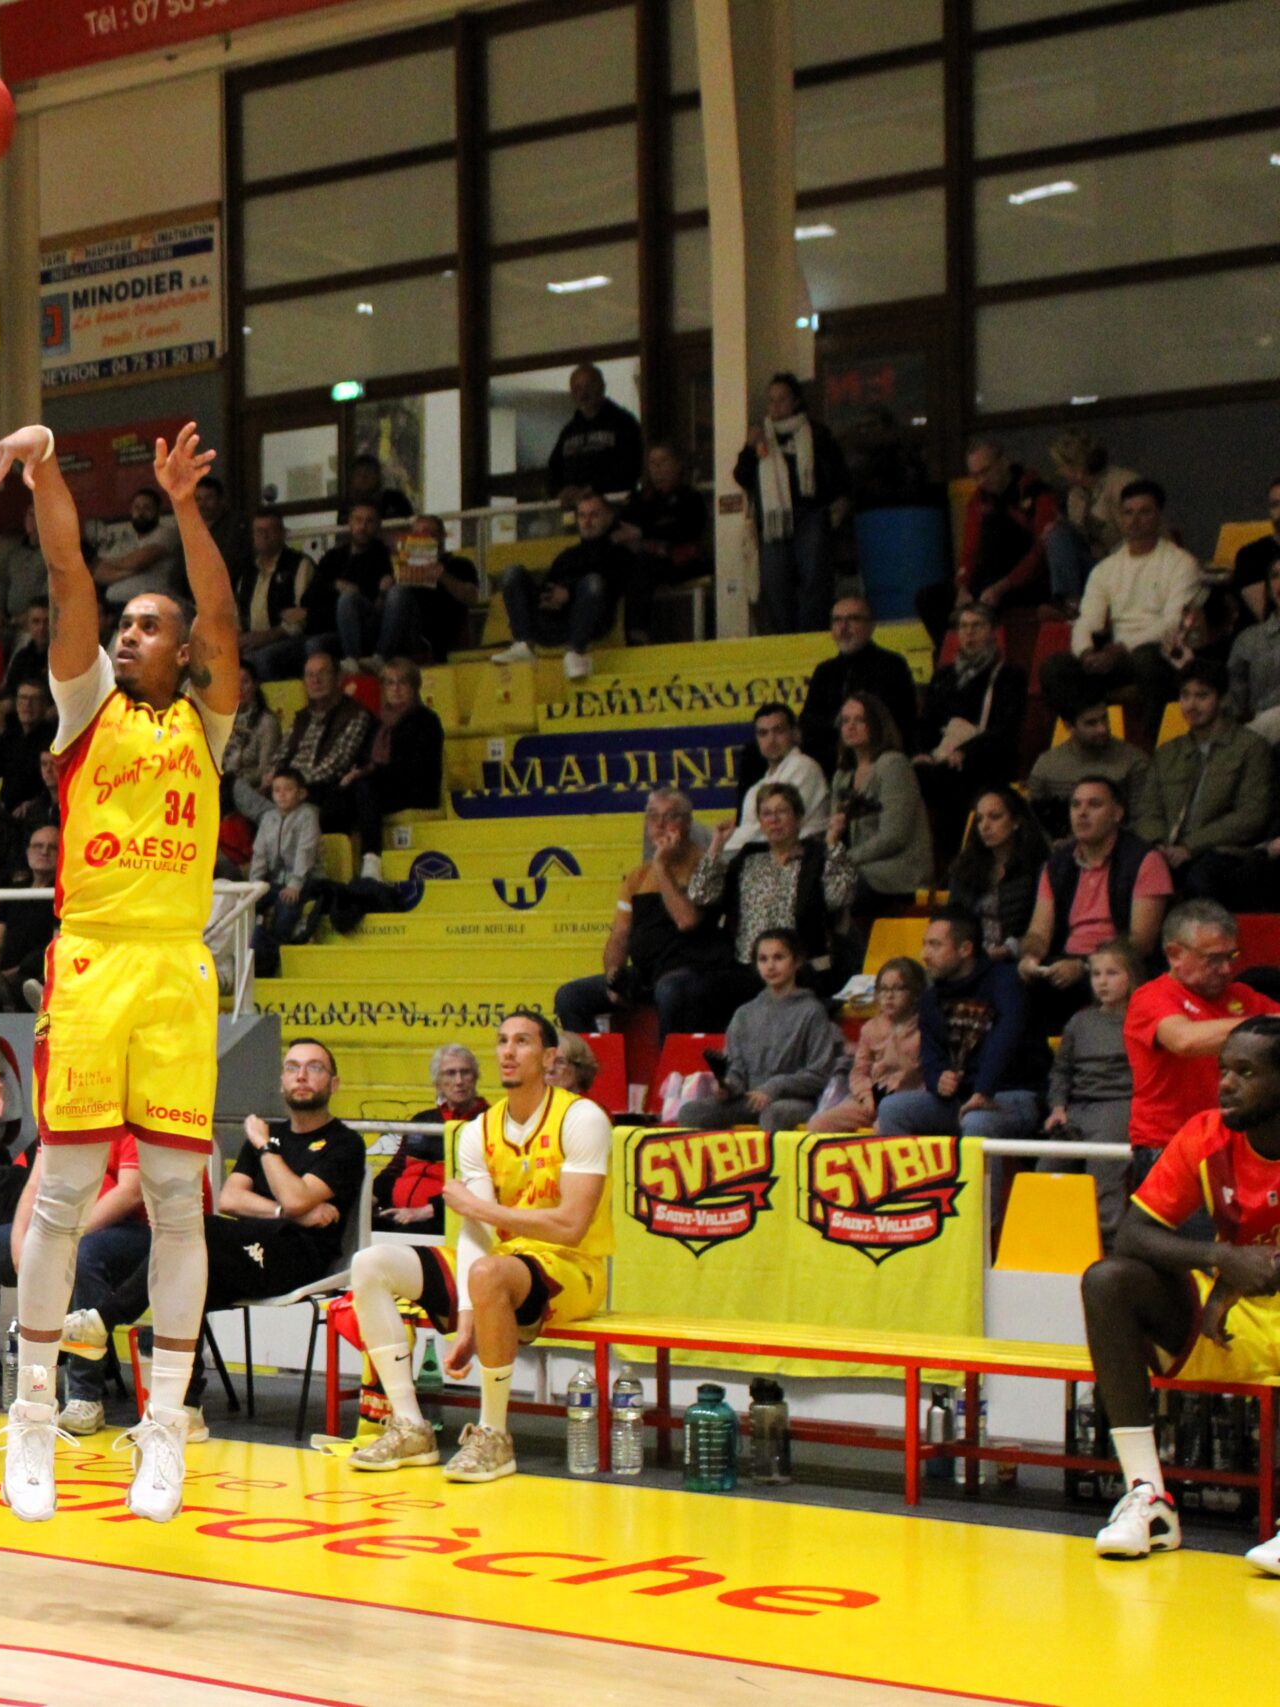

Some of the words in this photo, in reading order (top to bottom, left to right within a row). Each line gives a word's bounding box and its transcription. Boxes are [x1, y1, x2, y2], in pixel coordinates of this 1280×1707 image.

[73, 270, 184, 310] MINODIER
[165, 789, 196, 829] 34
[119, 858, 188, 874] MUTUELLE
[126, 836, 197, 863] AÉSIO
[146, 1100, 207, 1127] koesio
[640, 1129, 767, 1200] SVBD
[813, 1134, 953, 1209] SVBD
[305, 1490, 446, 1513] de
